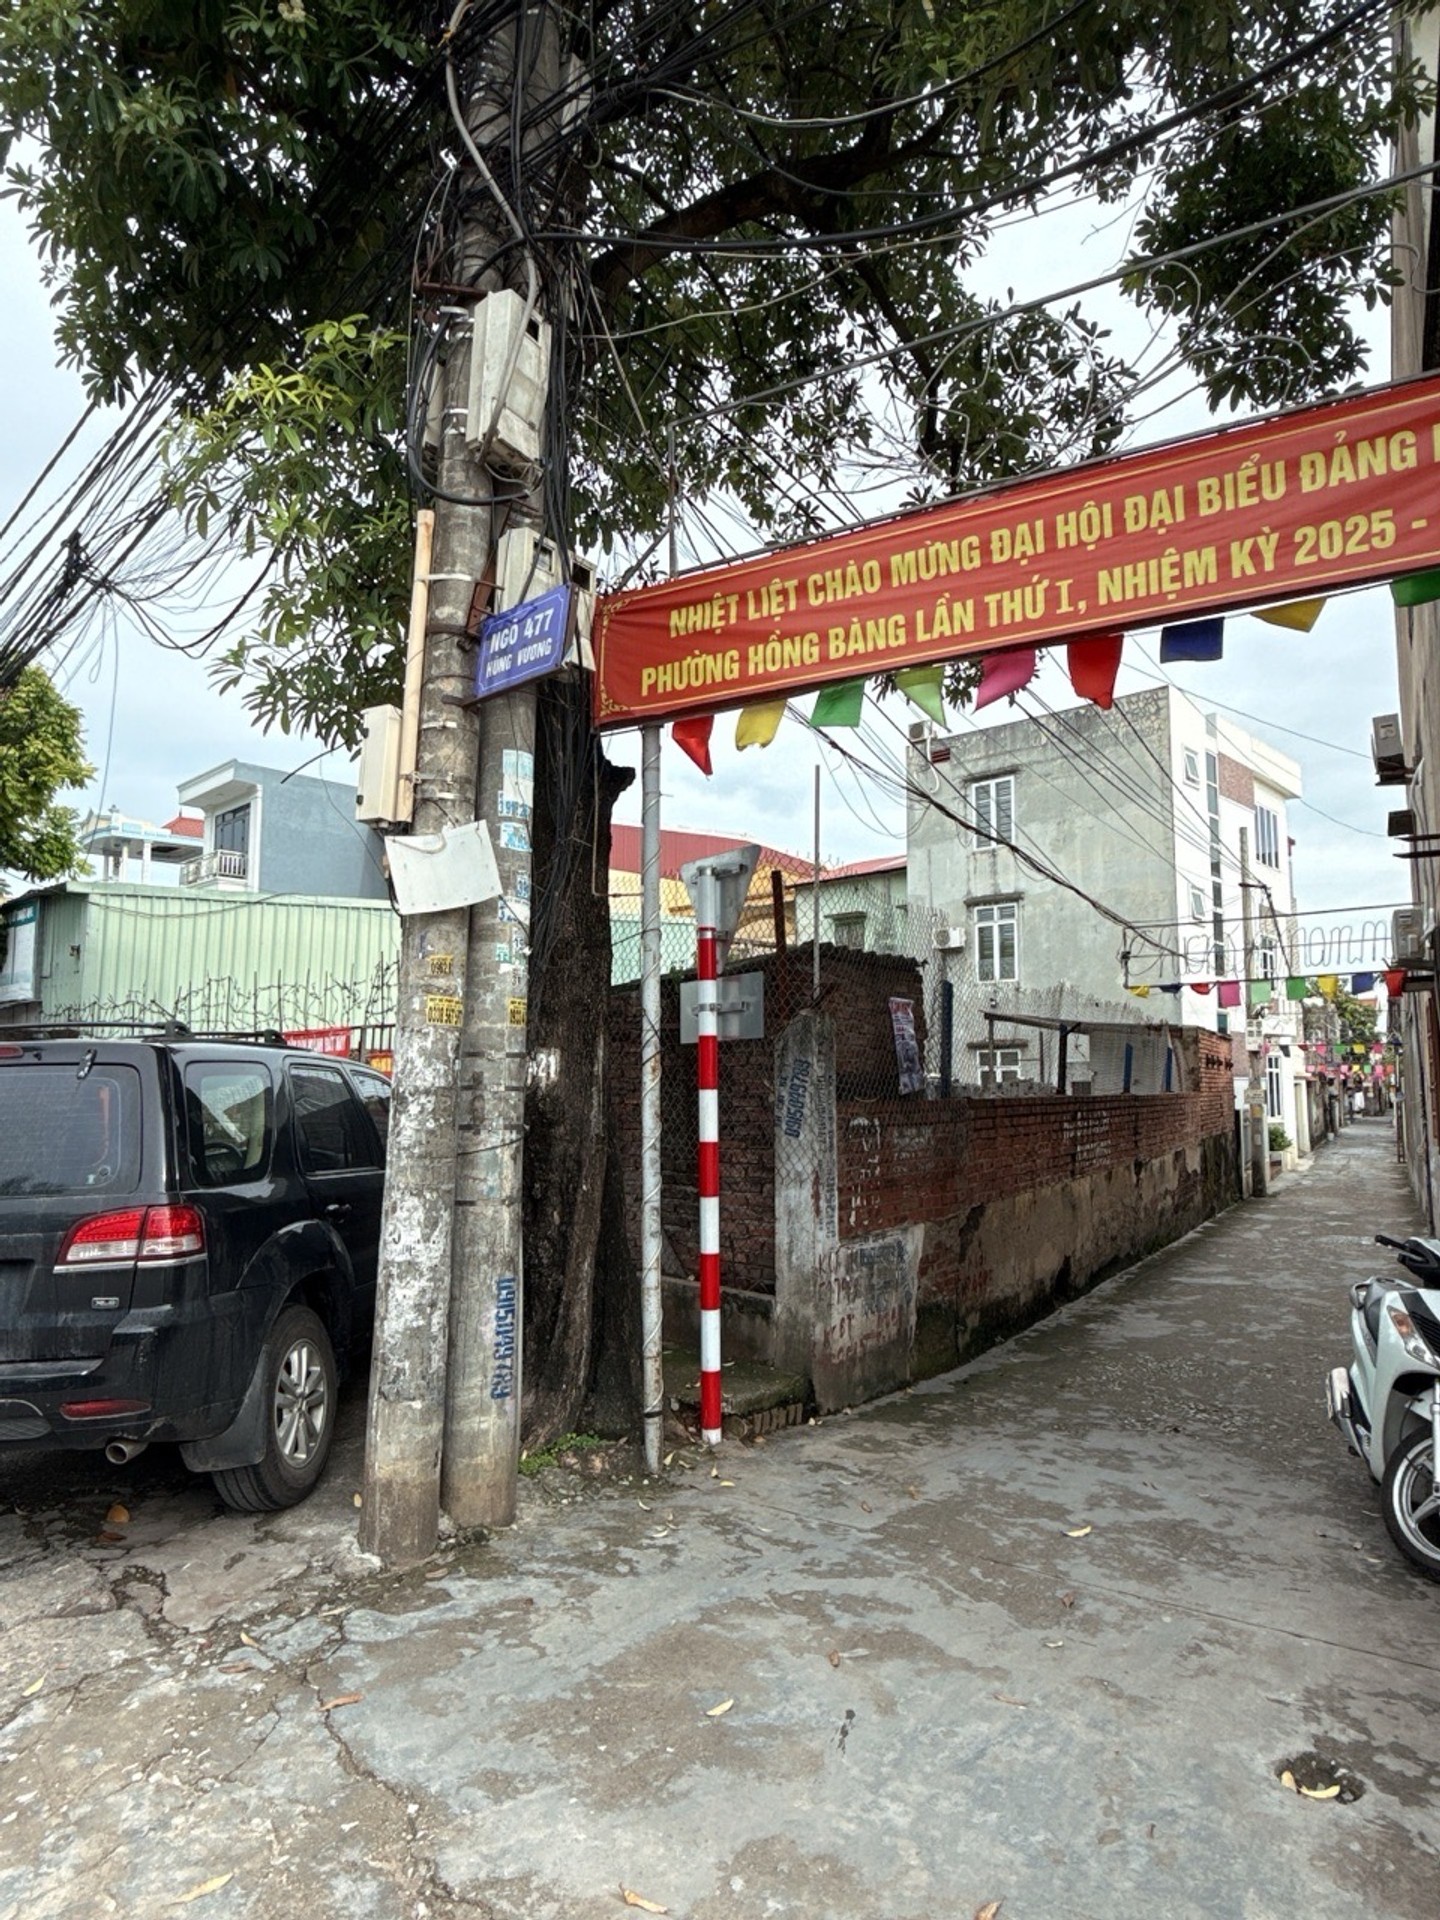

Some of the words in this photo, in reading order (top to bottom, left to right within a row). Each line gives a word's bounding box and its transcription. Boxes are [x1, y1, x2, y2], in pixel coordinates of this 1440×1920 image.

[524, 607, 554, 639] 477
[641, 648, 739, 697] PHƯỜNG
[748, 629, 819, 676] HỒNG
[828, 613, 907, 659] BÀNG
[916, 592, 975, 643] LẦN
[984, 572, 1049, 628] THỨ
[1097, 547, 1218, 606] NHIỆM
[1231, 526, 1280, 579] KỲ
[1293, 509, 1396, 566] 2025
[669, 592, 739, 639] NHIỆT
[747, 577, 798, 623] LIỆT
[807, 558, 880, 606] CHÀO
[891, 534, 980, 587] MỪNG
[991, 519, 1045, 566] ĐẠI
[1056, 501, 1112, 551] HỘI
[1124, 485, 1186, 536] ĐẠI
[1198, 452, 1287, 517] BIỂU
[1299, 430, 1417, 494] ĐẢNG
